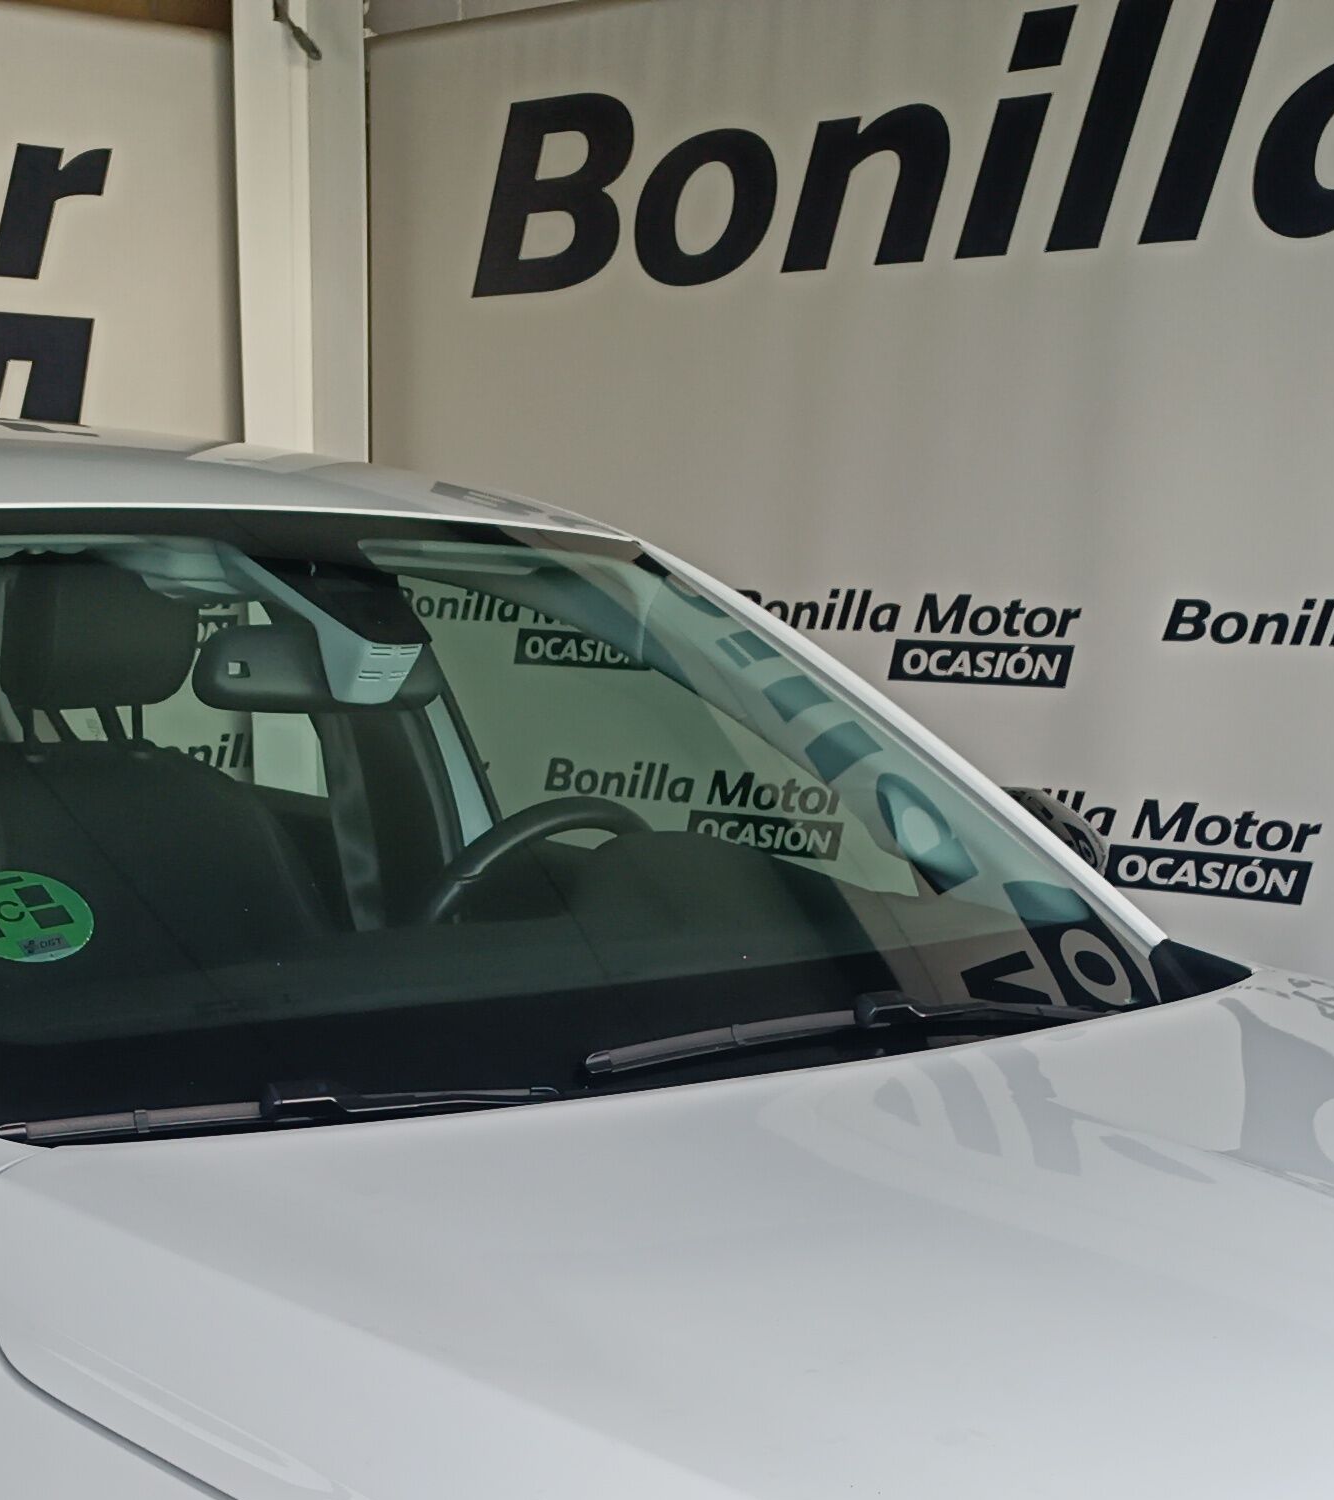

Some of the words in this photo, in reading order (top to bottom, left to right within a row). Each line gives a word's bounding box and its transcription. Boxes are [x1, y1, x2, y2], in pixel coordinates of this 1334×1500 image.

[914, 593, 1082, 638] Motor
[902, 646, 1063, 682] OCASIÓN
[544, 757, 695, 805] Bonilla
[1131, 799, 1322, 853] Motor
[1117, 853, 1299, 897] OCASIÓN
